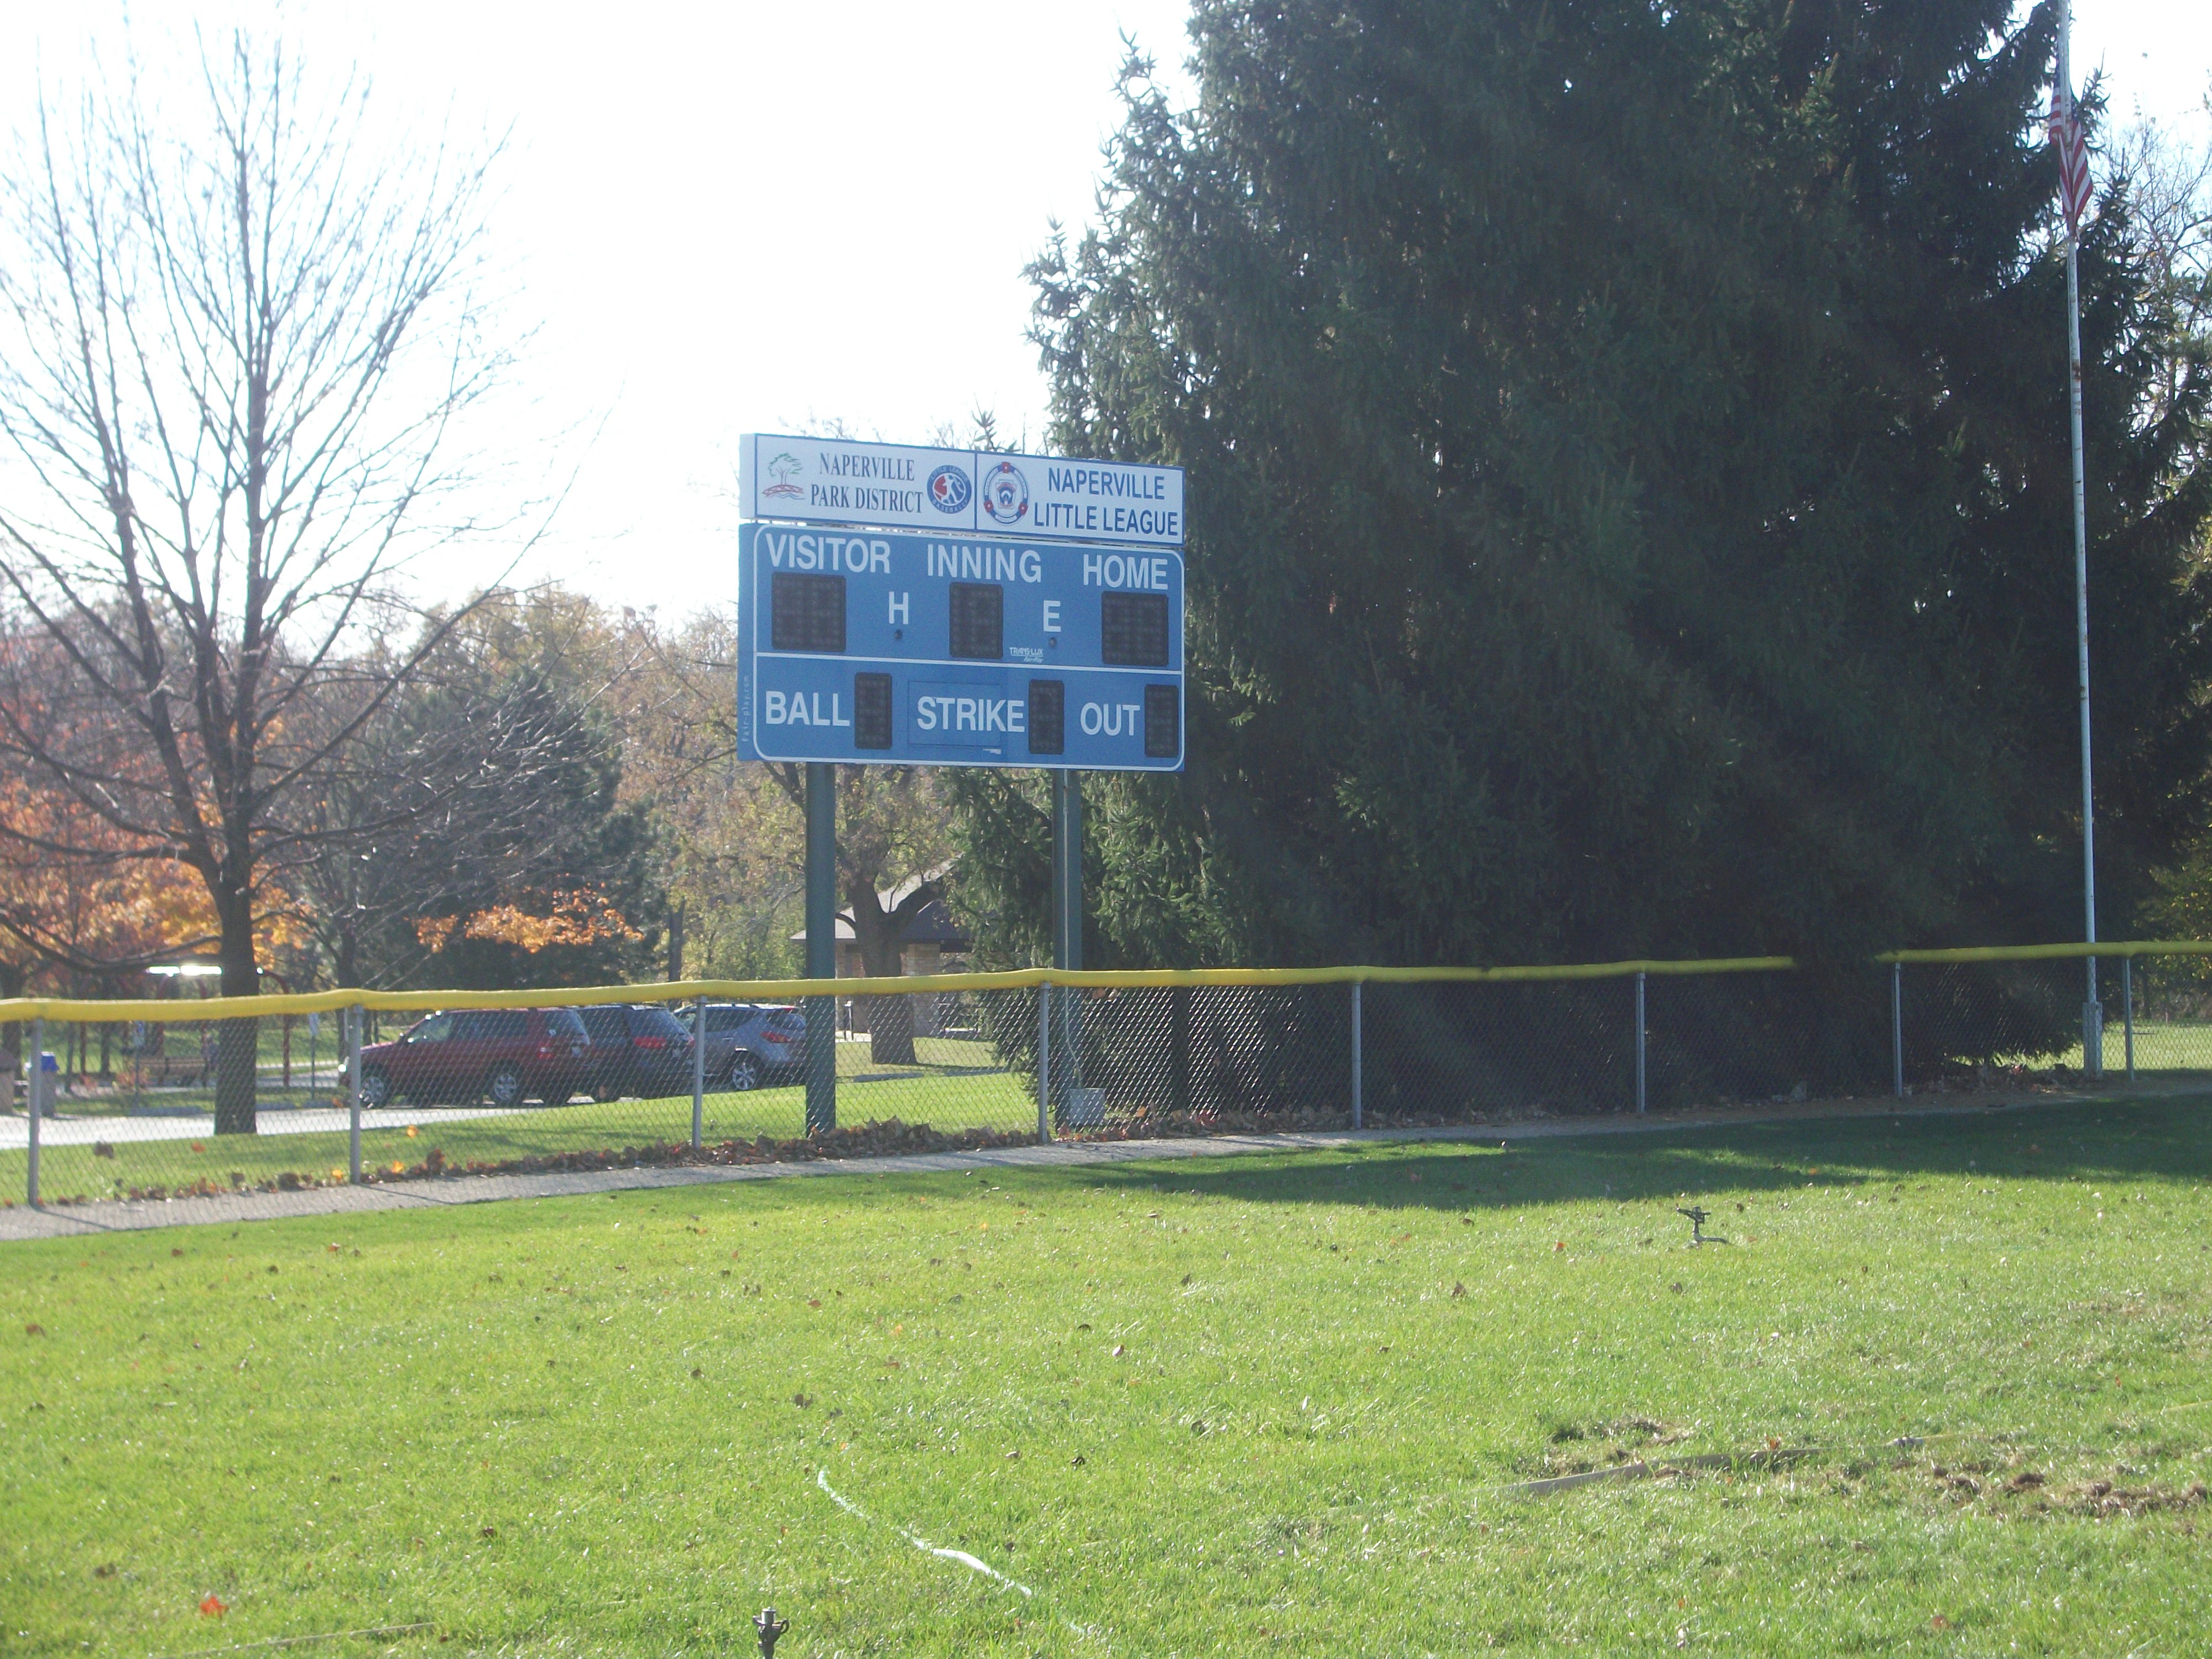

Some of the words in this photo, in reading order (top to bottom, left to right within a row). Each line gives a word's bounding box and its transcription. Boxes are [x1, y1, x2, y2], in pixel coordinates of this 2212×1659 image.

[819, 453, 915, 481] NAPERVILLE
[1048, 467, 1165, 500] NAPERVILLE
[811, 484, 850, 508] PARK
[855, 487, 923, 513] DISTRICT
[1034, 502, 1097, 530] LITTLE
[1103, 507, 1178, 536] LEAGUE
[765, 533, 890, 573] VISITOR
[927, 544, 1041, 583] INNING
[1083, 554, 1168, 590] HOME
[888, 591, 909, 625] H
[1043, 599, 1061, 632] E
[765, 691, 850, 727] BALL
[917, 696, 1025, 733] STRIKE
[1080, 702, 1140, 736] OUT
